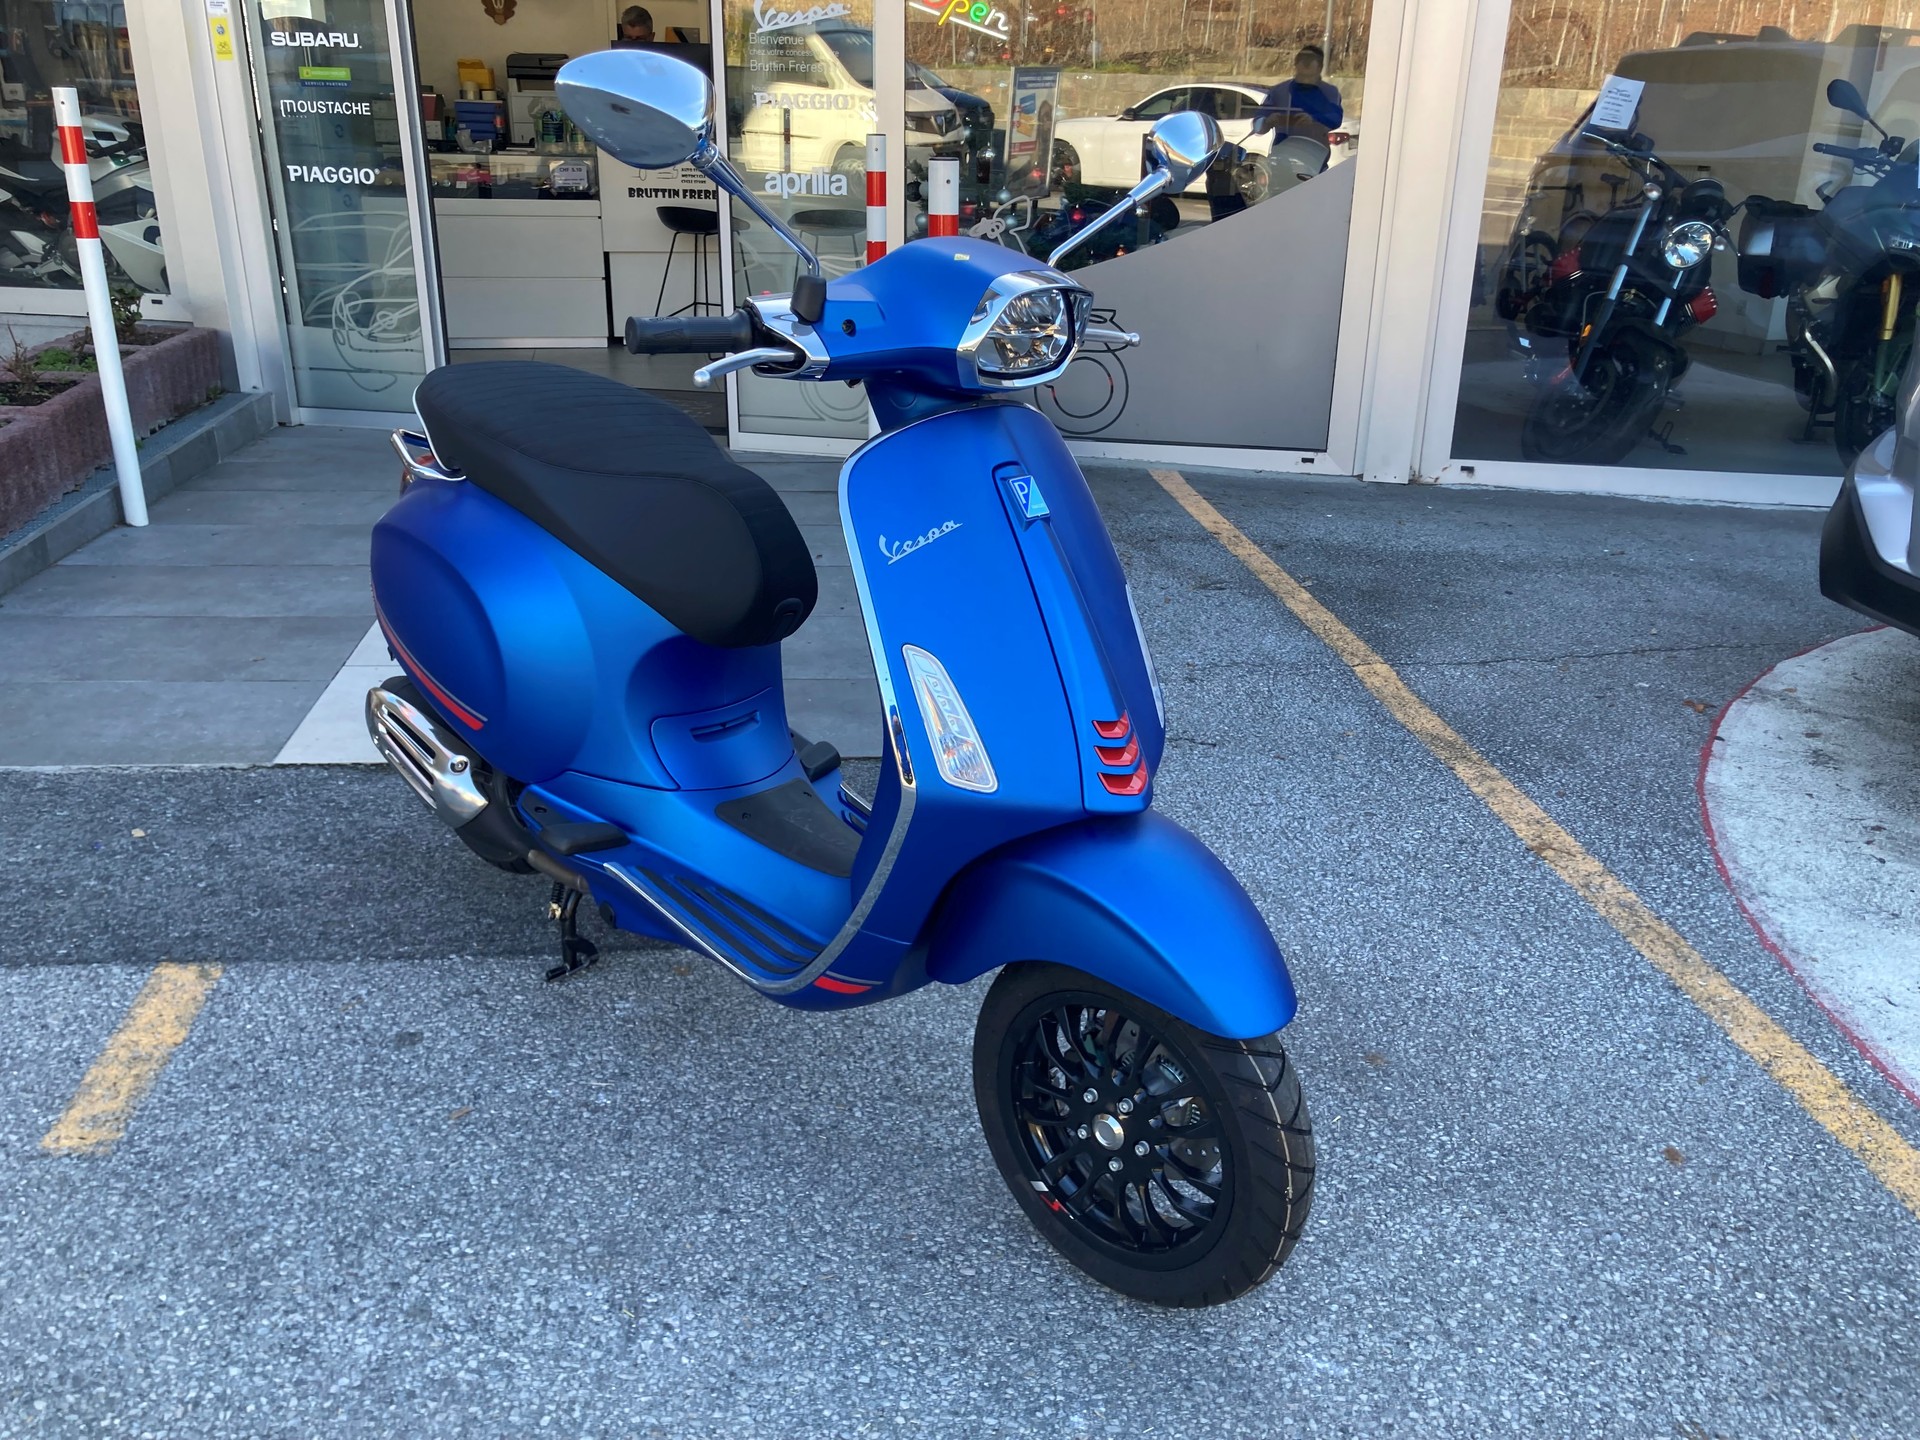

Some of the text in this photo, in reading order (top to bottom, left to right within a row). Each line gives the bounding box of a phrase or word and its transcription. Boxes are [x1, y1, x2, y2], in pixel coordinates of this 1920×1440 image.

[753, 0, 851, 33] Vespa
[270, 31, 359, 48] SUBARU
[748, 32, 805, 45] Bienvenue
[750, 59, 824, 73] Bruttin Frères
[280, 99, 371, 117] MOUSTACHE
[753, 92, 849, 110] PIAGGIO
[286, 164, 376, 185] PIAGGIO
[765, 167, 847, 199] aprilia
[627, 187, 718, 200] BRUTTIN FRERE
[1013, 481, 1029, 504] P
[879, 520, 963, 565] Vespa
